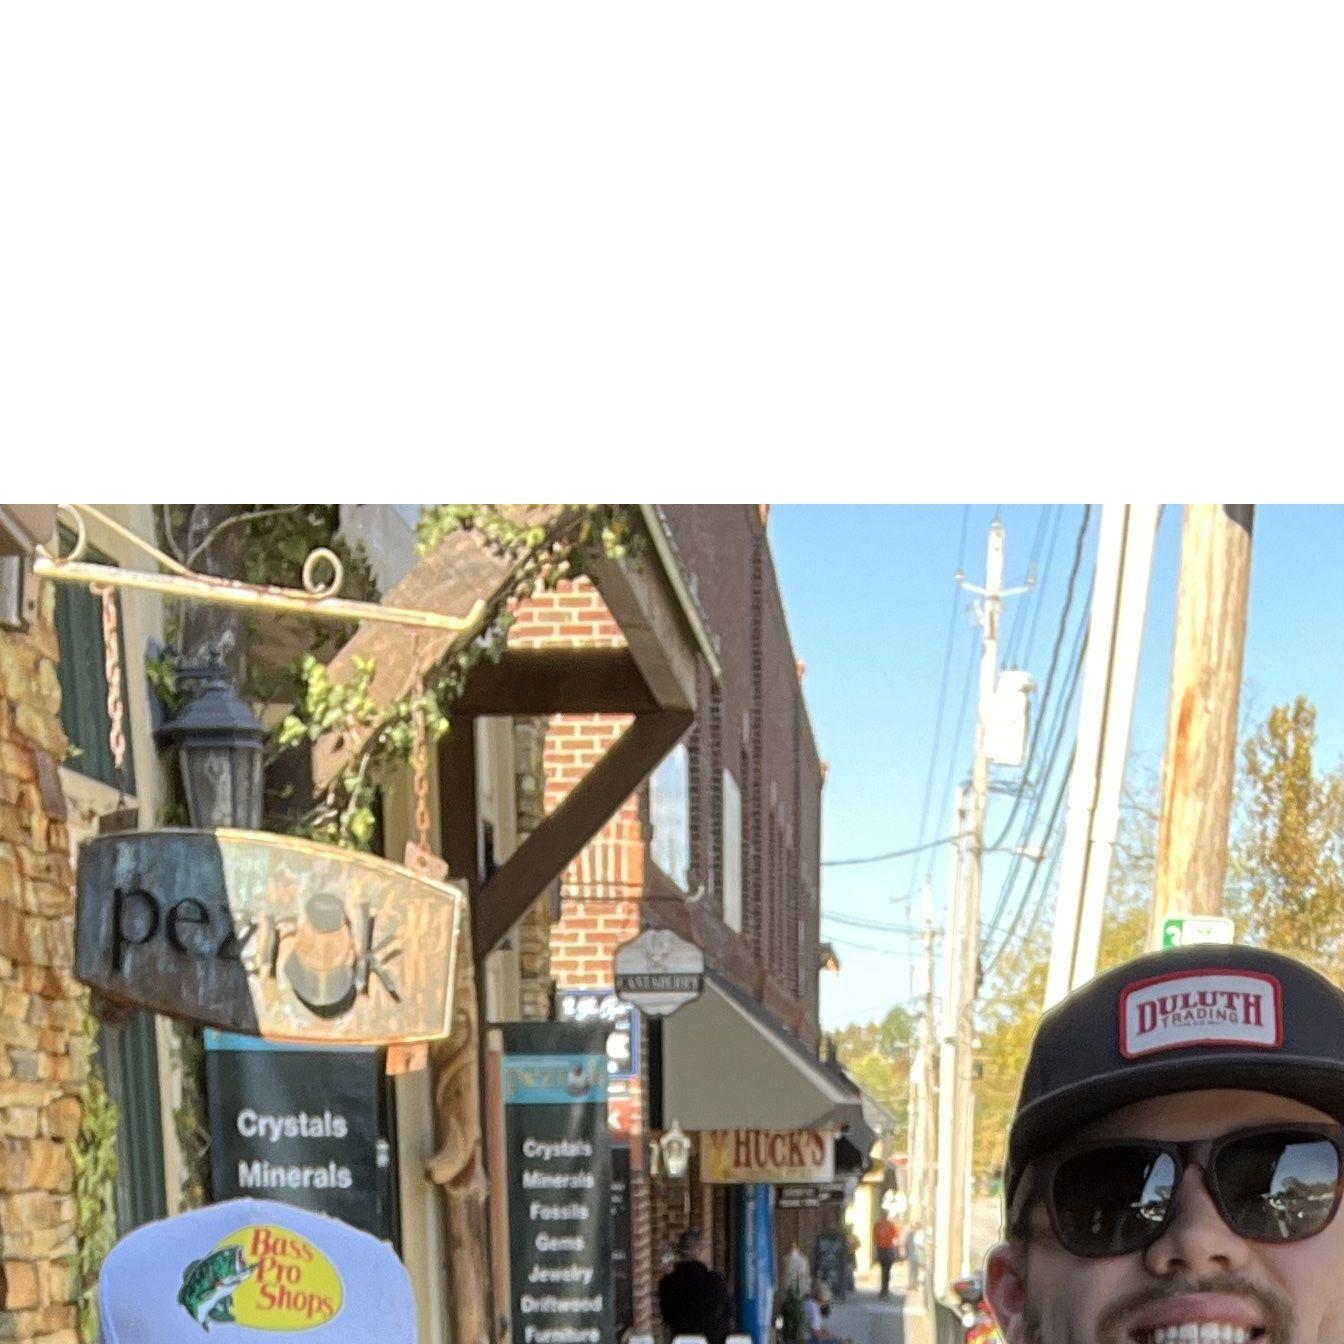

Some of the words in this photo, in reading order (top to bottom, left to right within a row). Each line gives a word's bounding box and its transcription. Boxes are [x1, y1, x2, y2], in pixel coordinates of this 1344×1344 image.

[1136, 989, 1264, 1036] DULUTH
[1161, 1007, 1240, 1029] TRADING
[236, 1107, 349, 1142] Crystals
[522, 1138, 594, 1161] Crystals
[734, 1130, 826, 1168] HUCK'S
[237, 1160, 353, 1189] Minerals
[522, 1169, 595, 1189] Minerals
[529, 1201, 590, 1221] Fossils
[249, 1227, 314, 1264] Bass
[535, 1232, 586, 1252] Gems
[256, 1256, 302, 1285] Pro
[528, 1264, 594, 1286] Jewelry
[257, 1283, 334, 1320] Shops
[520, 1293, 604, 1314] Driftwood
[524, 1324, 601, 1344] Furniture
